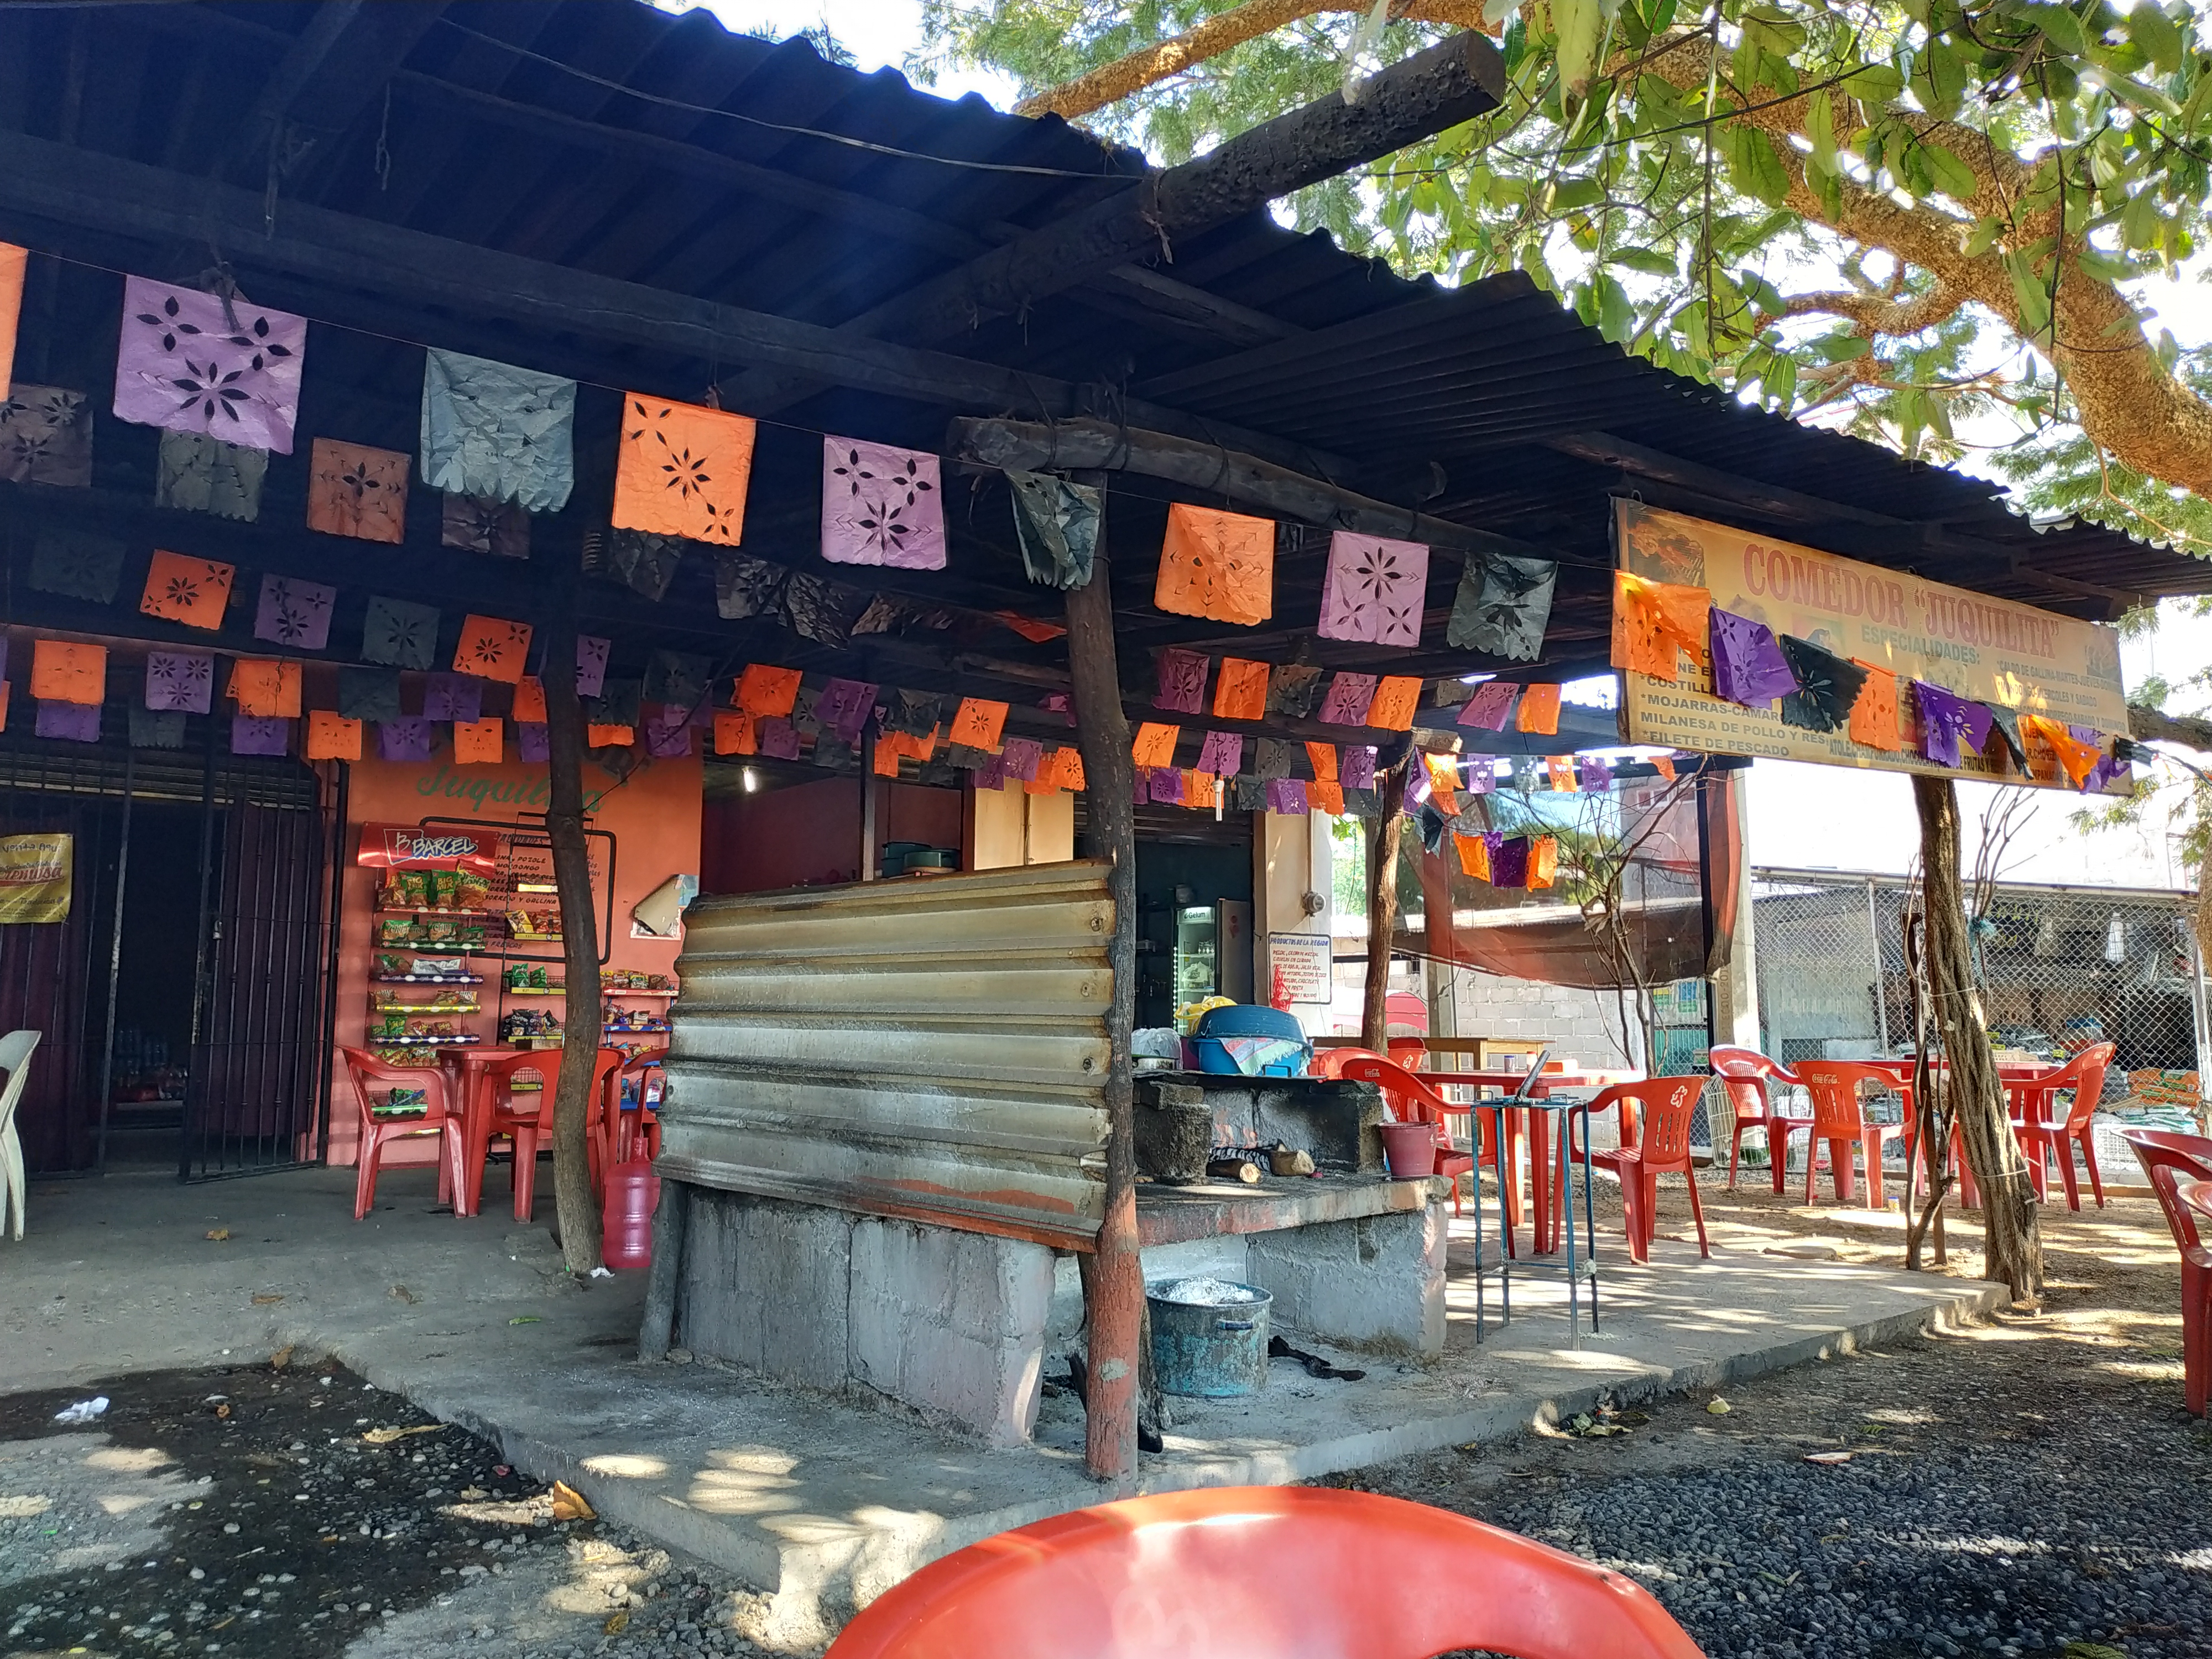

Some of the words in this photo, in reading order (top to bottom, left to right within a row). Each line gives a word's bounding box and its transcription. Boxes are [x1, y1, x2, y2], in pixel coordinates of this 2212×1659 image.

[1744, 544, 1908, 629] COMEDOR
[1861, 624, 1980, 665] ESPECIALIDADES:
[1641, 711, 1717, 731] MILANESA
[1721, 722, 1739, 733] DE
[1744, 725, 1786, 739] POLLO
[1789, 731, 1798, 741] Y
[1802, 733, 1826, 745] RES
[1705, 737, 1723, 749] DE
[1728, 739, 1790, 757] PESCADO
[412, 837, 478, 858] BARCEL
[437, 876, 453, 884] BIG
